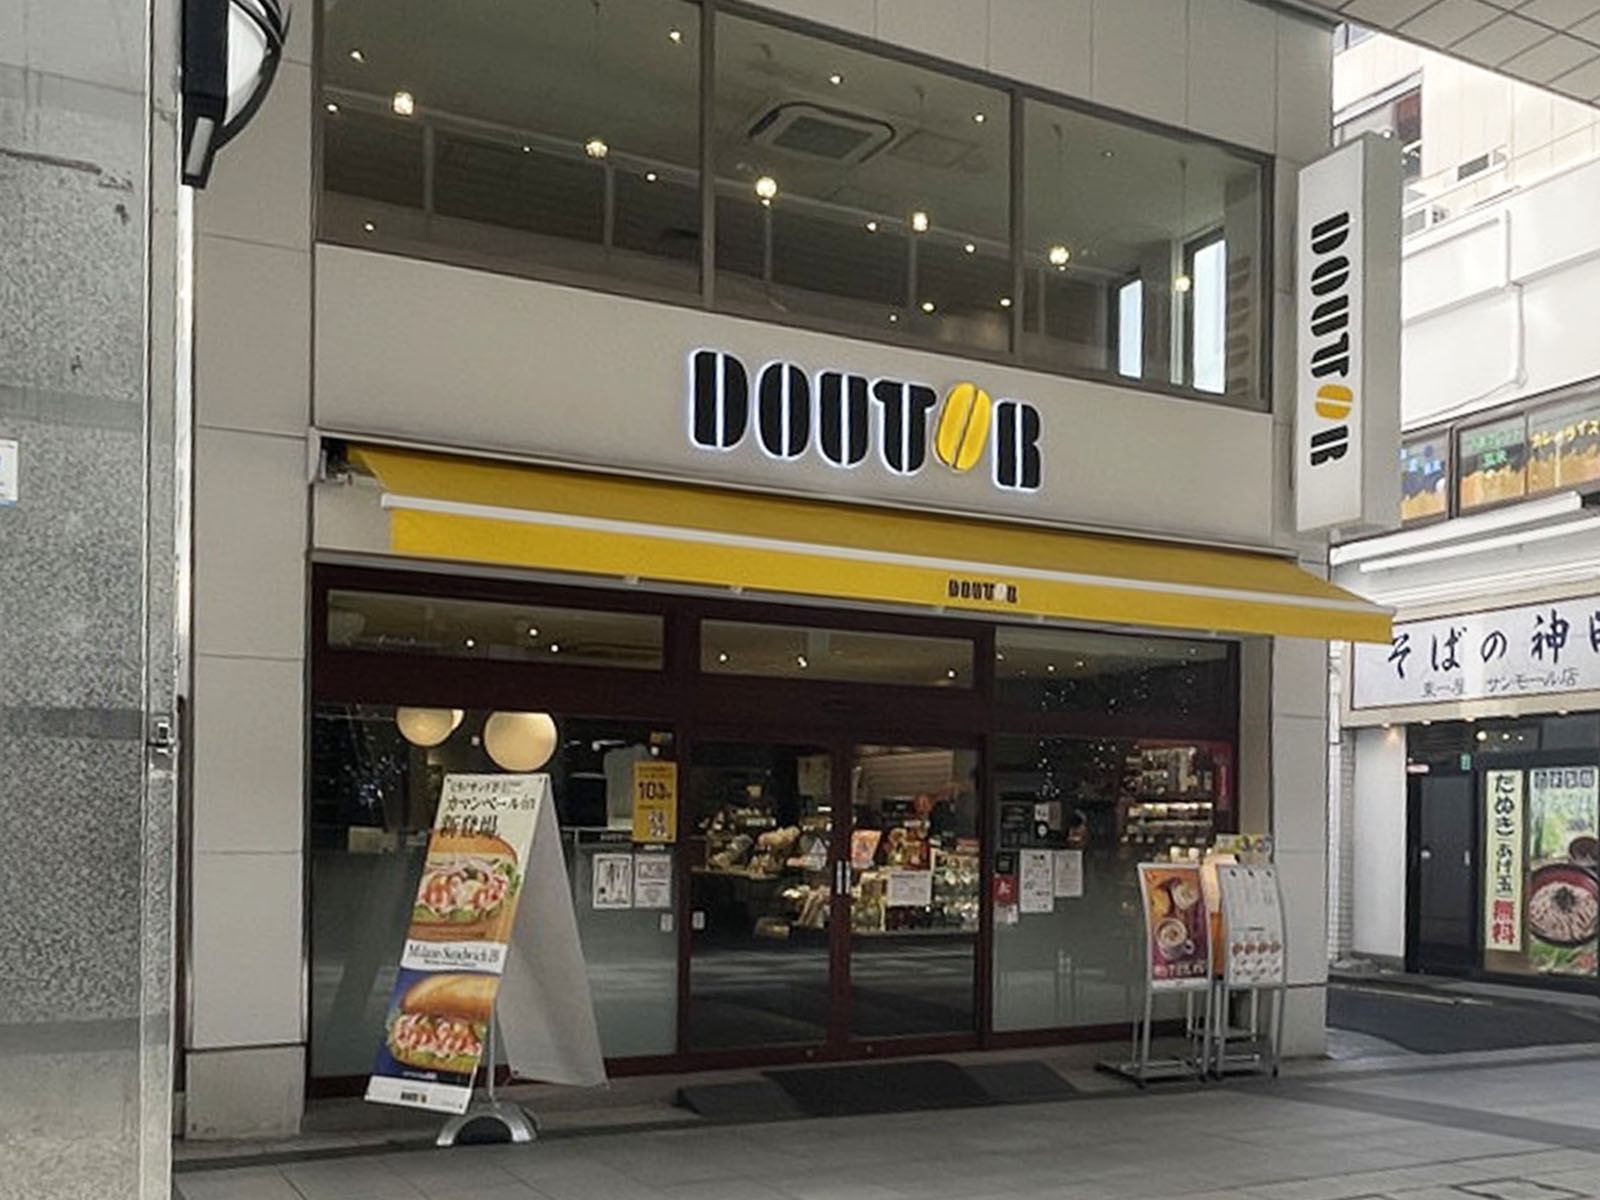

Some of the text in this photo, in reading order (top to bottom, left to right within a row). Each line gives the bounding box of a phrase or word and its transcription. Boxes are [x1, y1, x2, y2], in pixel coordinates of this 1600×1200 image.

[1310, 211, 1353, 467] DOUTOR
[691, 350, 1043, 491] DOUTOR
[948, 579, 1017, 603] DOUTOR
